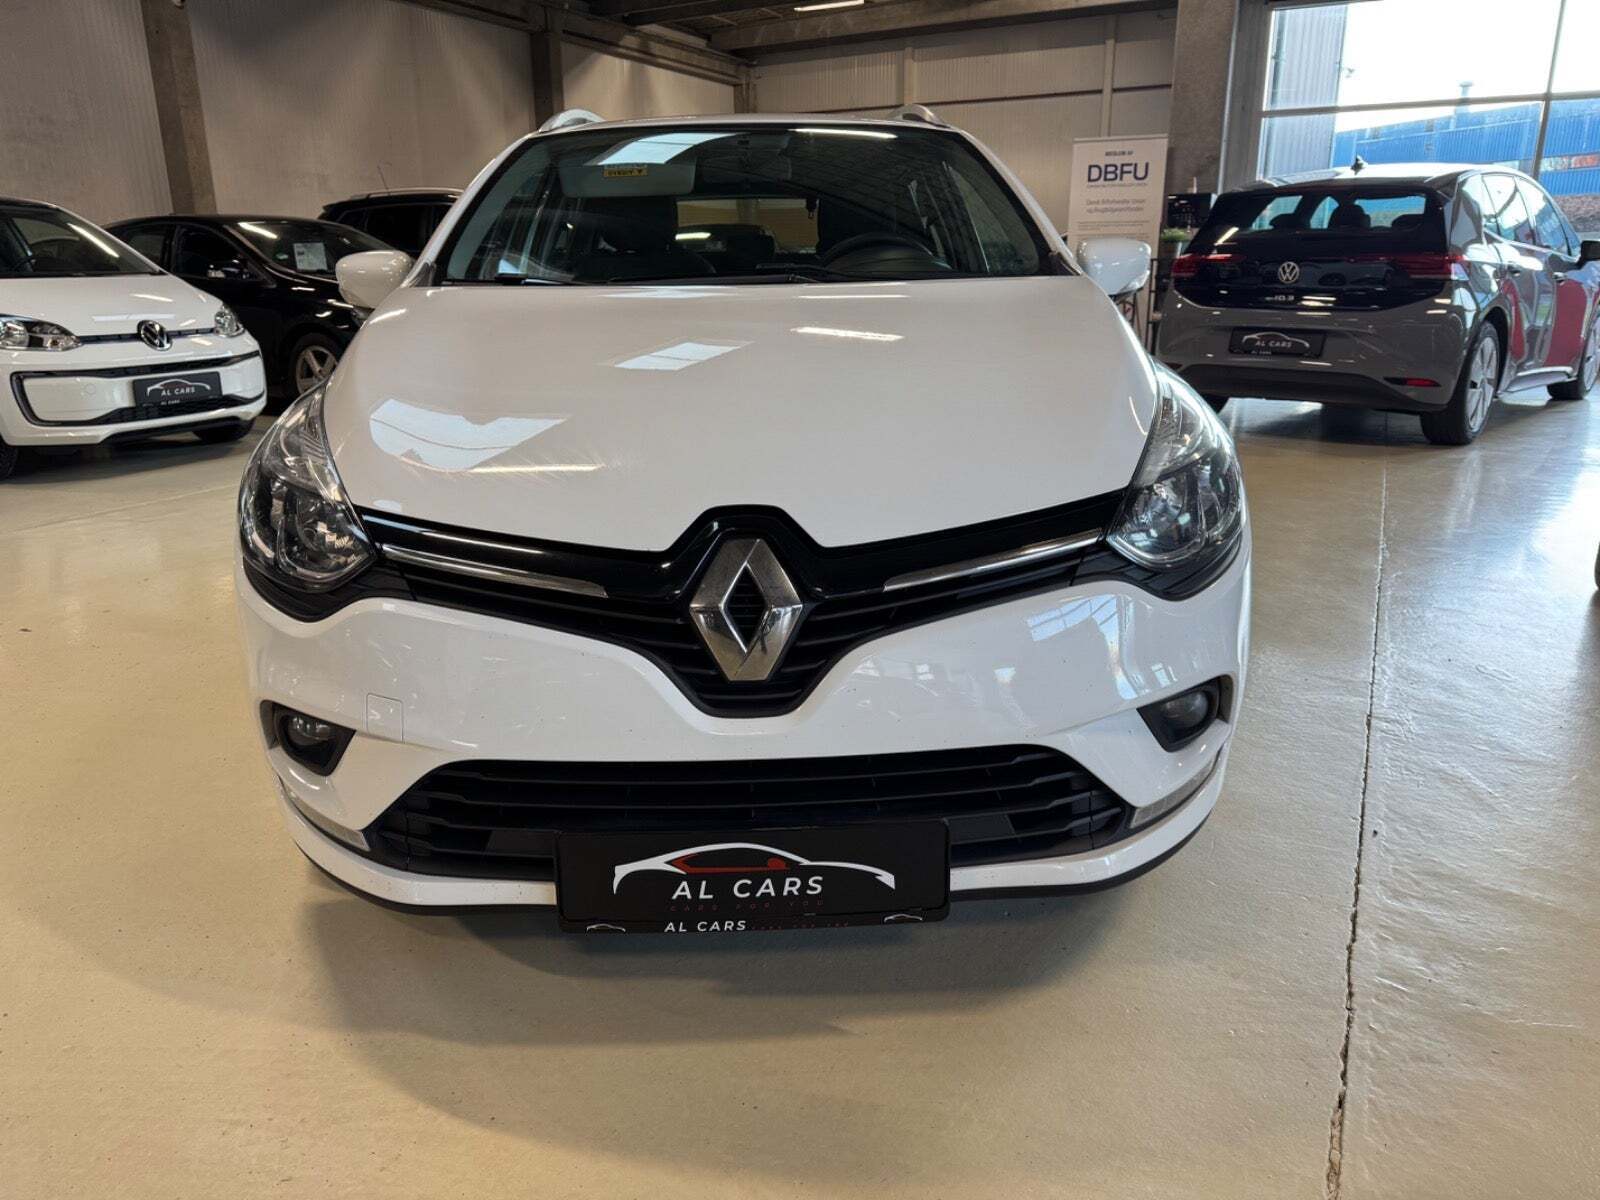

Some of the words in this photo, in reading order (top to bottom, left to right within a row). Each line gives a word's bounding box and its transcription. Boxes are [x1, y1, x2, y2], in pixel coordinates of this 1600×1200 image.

[1087, 162, 1150, 183] DBFU
[174, 387, 195, 395] CARS
[671, 880, 714, 900] AL
[732, 876, 824, 899] CARS
[663, 922, 687, 933] AL
[696, 920, 747, 932] CARS
